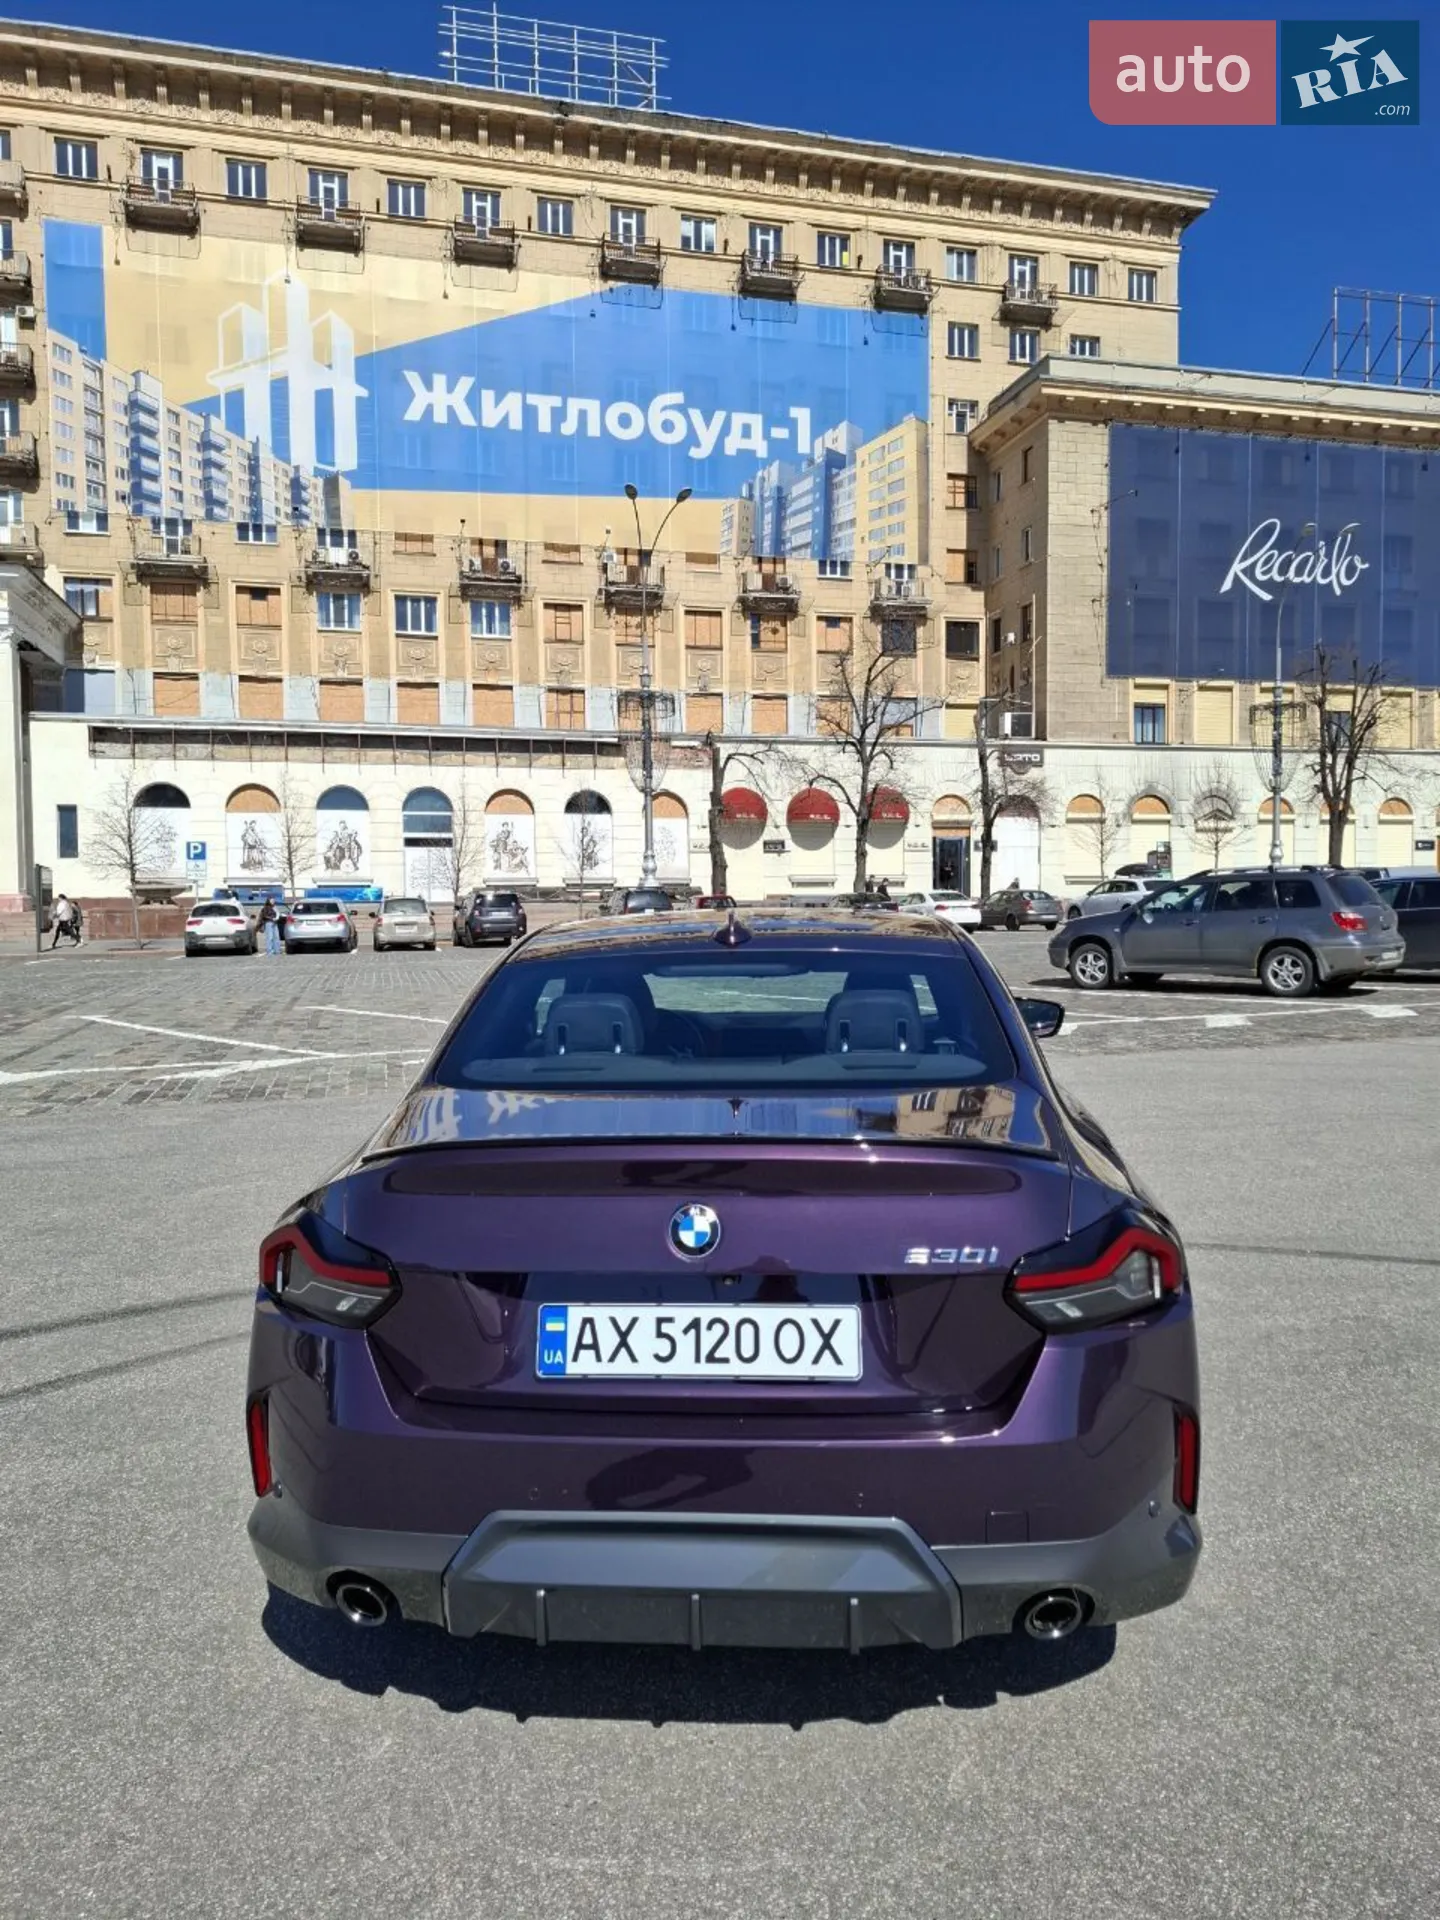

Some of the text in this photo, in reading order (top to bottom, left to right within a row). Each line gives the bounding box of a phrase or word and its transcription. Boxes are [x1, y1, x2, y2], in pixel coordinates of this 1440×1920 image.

[402, 370, 811, 460] Житлобуд-1
[1219, 518, 1370, 601] Recarlo
[190, 843, 202, 859] P
[544, 1351, 564, 1365] UA
[571, 1316, 844, 1366] AX 5120 OX
